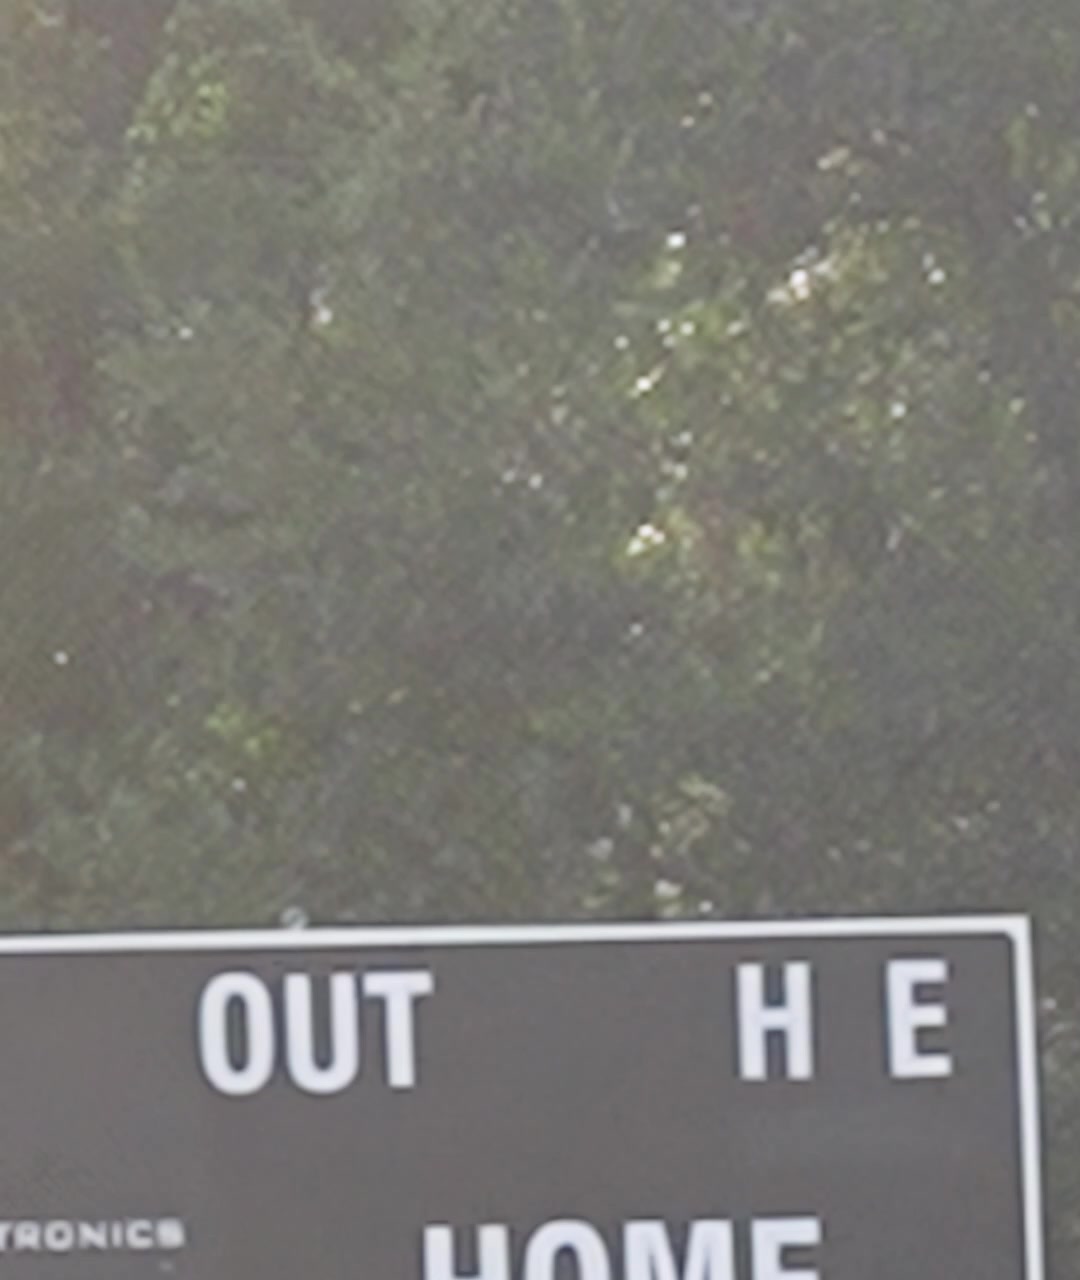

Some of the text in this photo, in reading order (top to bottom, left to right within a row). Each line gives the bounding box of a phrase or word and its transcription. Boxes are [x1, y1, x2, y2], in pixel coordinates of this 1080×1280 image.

[200, 972, 433, 1094] OUT
[737, 960, 952, 1080] H E
